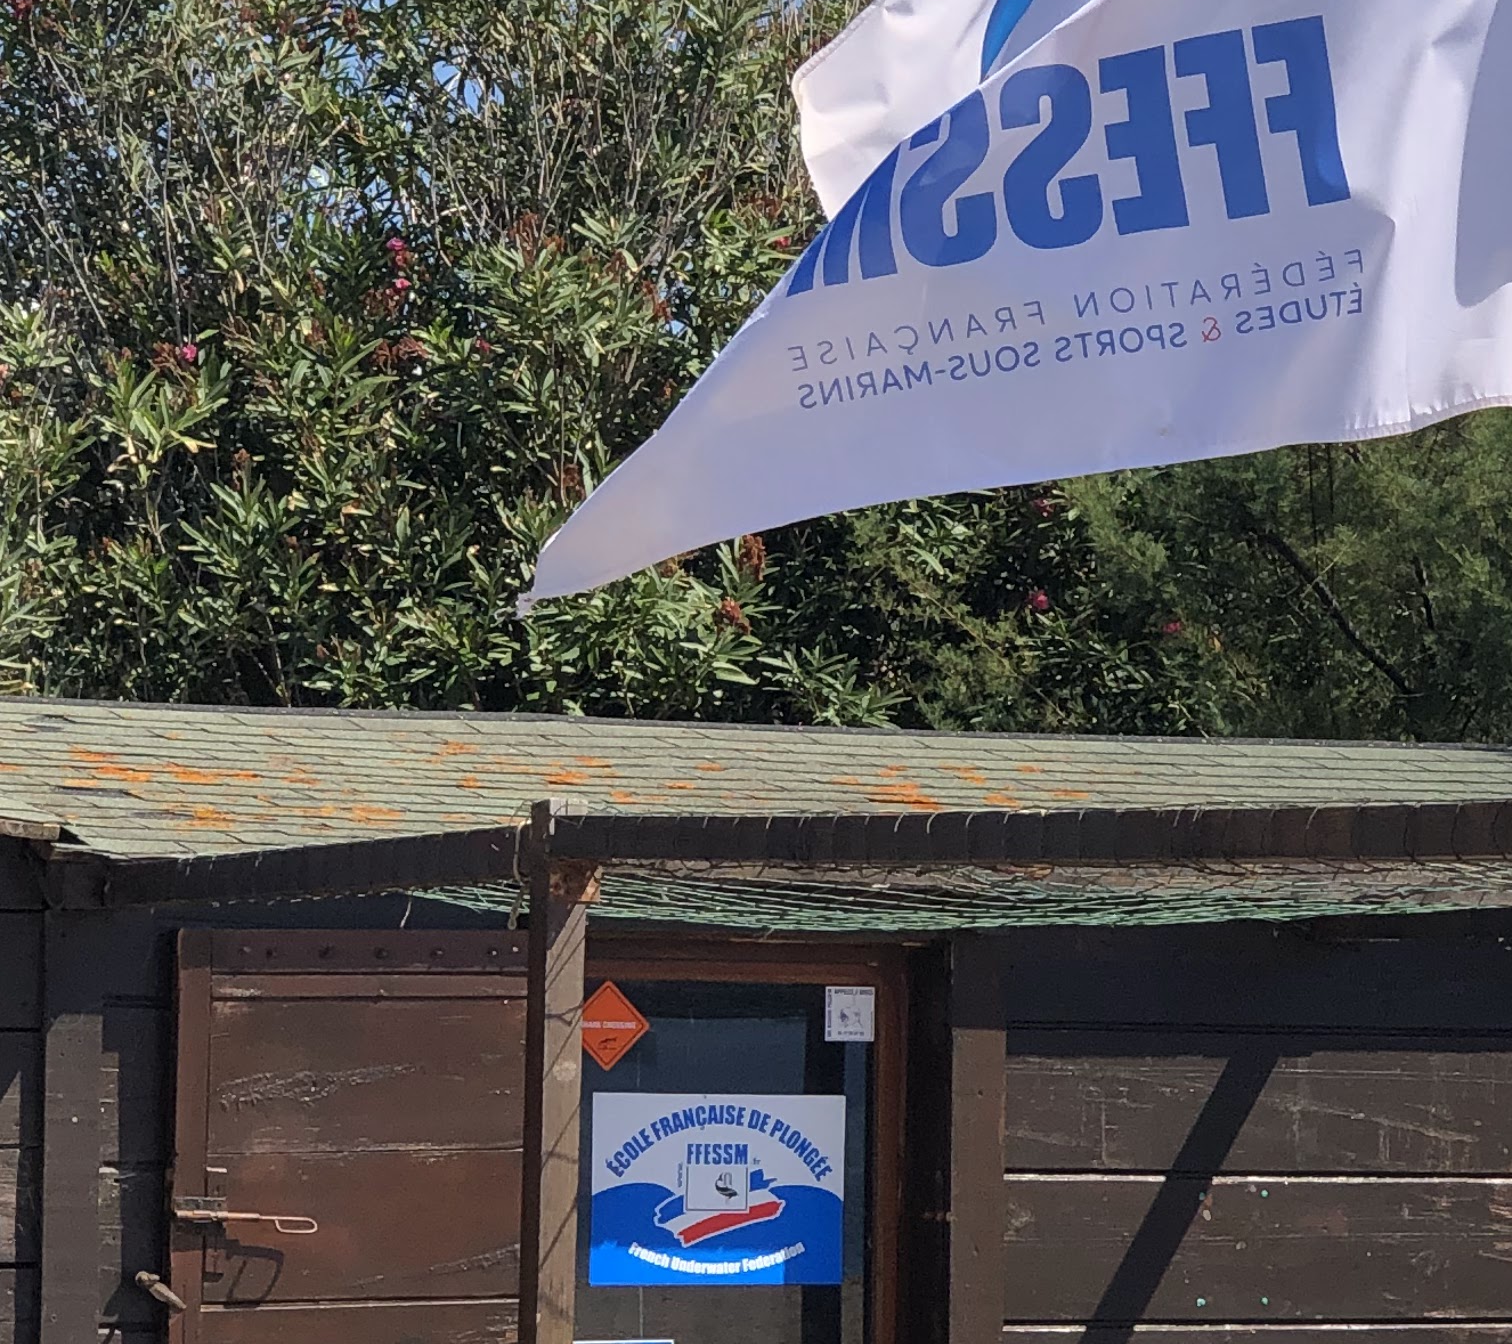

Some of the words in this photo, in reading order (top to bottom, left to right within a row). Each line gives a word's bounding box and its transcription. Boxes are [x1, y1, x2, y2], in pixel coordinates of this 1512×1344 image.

[605, 1128, 655, 1178] ÉCOLE
[651, 1105, 747, 1142] FRANÇAISE
[748, 1109, 772, 1134] DE
[769, 1119, 833, 1182] PLONGÉE
[686, 1143, 749, 1165] FFESSM
[628, 1241, 670, 1268] French
[670, 1255, 741, 1275] Underwater
[742, 1241, 806, 1272] Federation
